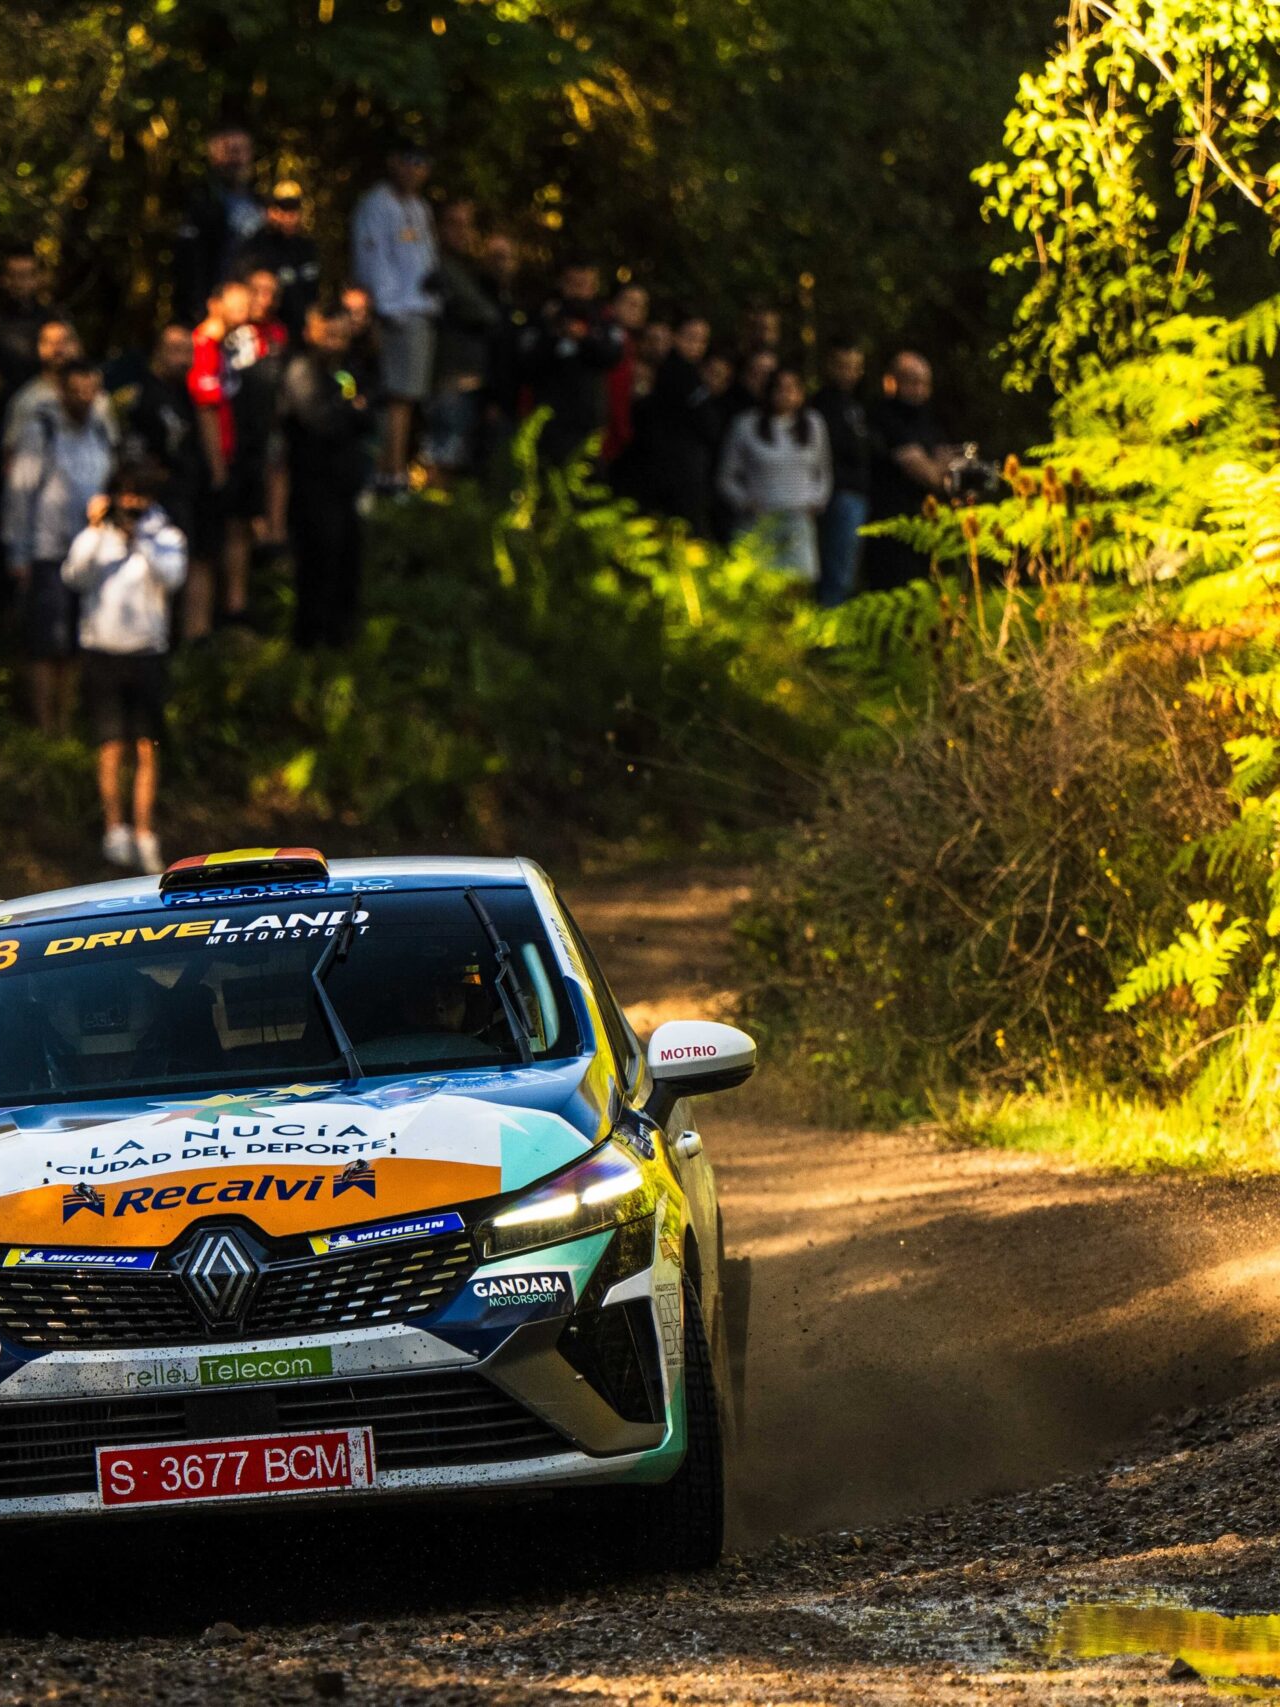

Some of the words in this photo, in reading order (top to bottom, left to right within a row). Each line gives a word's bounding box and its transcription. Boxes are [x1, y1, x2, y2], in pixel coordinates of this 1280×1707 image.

[163, 878, 393, 906] pantano
[175, 887, 326, 904] restaurante
[43, 910, 370, 957] DRIVELAND
[205, 925, 370, 946] MOTORSPOT
[661, 1045, 717, 1061] MOTRIO
[56, 1153, 173, 1175] CIUDAD
[181, 1144, 236, 1160] DEL
[246, 1138, 388, 1155] DEPORTE
[90, 1139, 145, 1159] LA
[112, 1175, 326, 1217] Recalvi
[357, 1220, 445, 1242] MICHELIN
[47, 1254, 139, 1264] MICHELIN
[473, 1276, 566, 1298] GANDARA
[489, 1292, 558, 1308] MOTORSPORT
[110, 1460, 136, 1495] S
[160, 1450, 250, 1492] 3677
[264, 1442, 348, 1484] BCM
